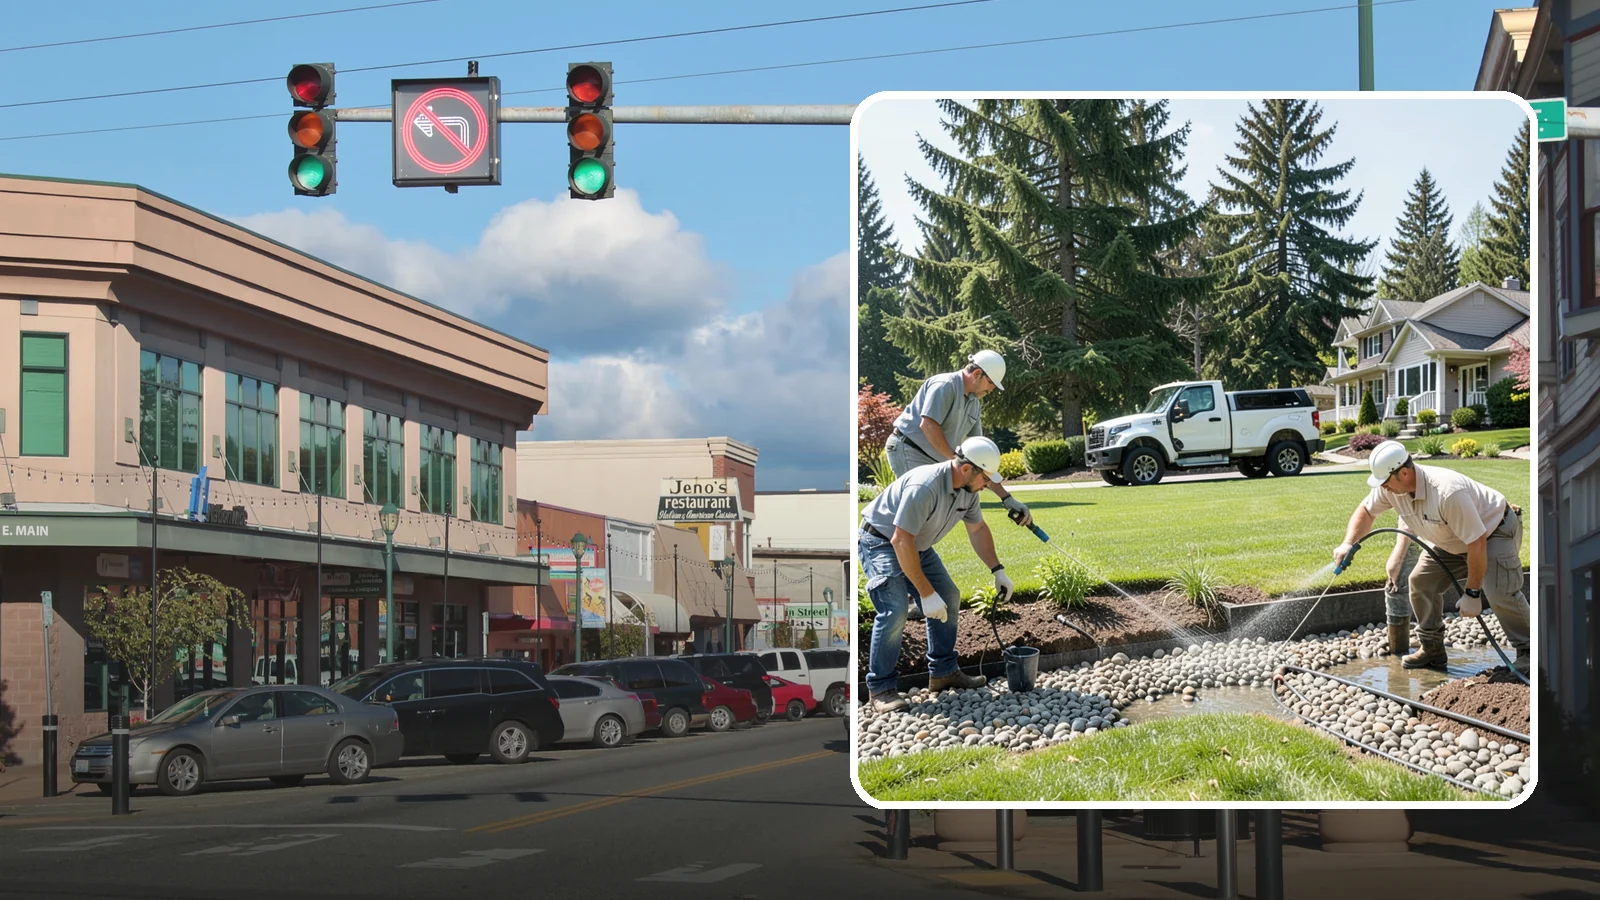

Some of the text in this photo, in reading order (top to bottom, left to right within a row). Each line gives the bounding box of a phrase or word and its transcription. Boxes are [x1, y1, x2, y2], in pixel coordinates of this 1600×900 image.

[669, 480, 728, 495] Jeno's
[665, 496, 731, 509] restaurant
[686, 509, 715, 519] American
[715, 509, 737, 519] Cuisine
[2, 525, 49, 536] E. MAIN
[797, 607, 828, 617] Street
